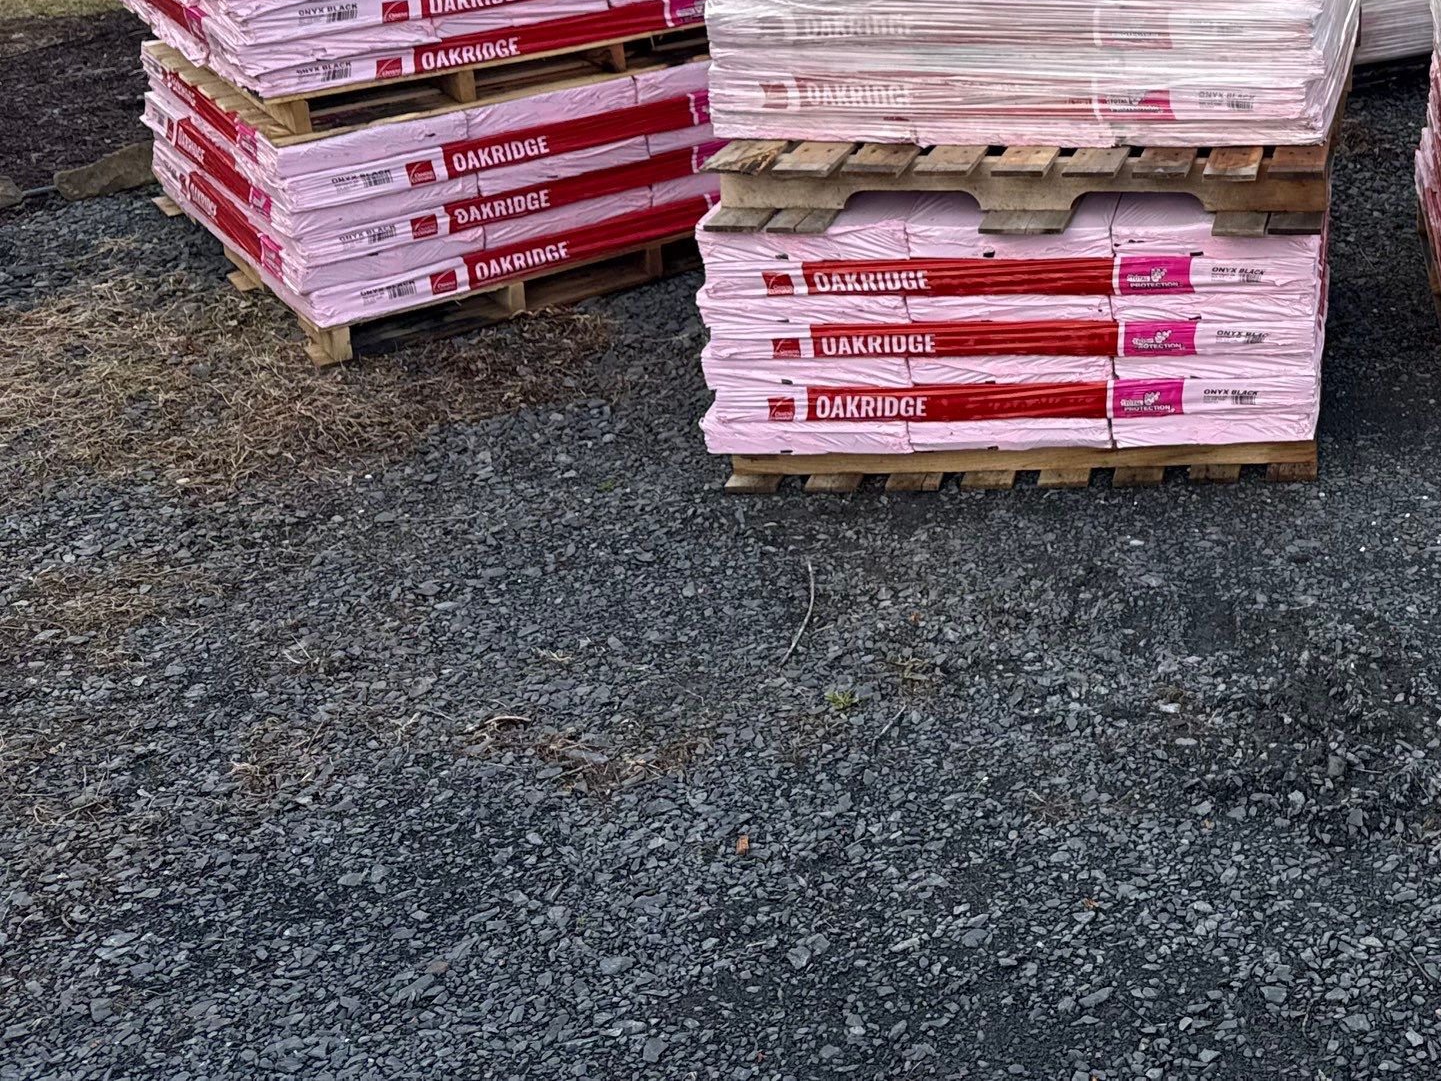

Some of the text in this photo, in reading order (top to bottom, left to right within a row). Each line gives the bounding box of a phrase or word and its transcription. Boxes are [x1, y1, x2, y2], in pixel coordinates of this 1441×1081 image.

[298, 3, 358, 16] ONYX BLACK
[422, 37, 521, 71] OAKRIDGE
[452, 136, 551, 172] OAKRIDGE
[454, 189, 551, 224] OAKRIDGE
[475, 241, 571, 281] OAKRIDGE
[814, 270, 931, 292] OAKRIDGE
[822, 334, 936, 355] OAKRIDGE
[816, 396, 928, 418] OAKRIDGE
